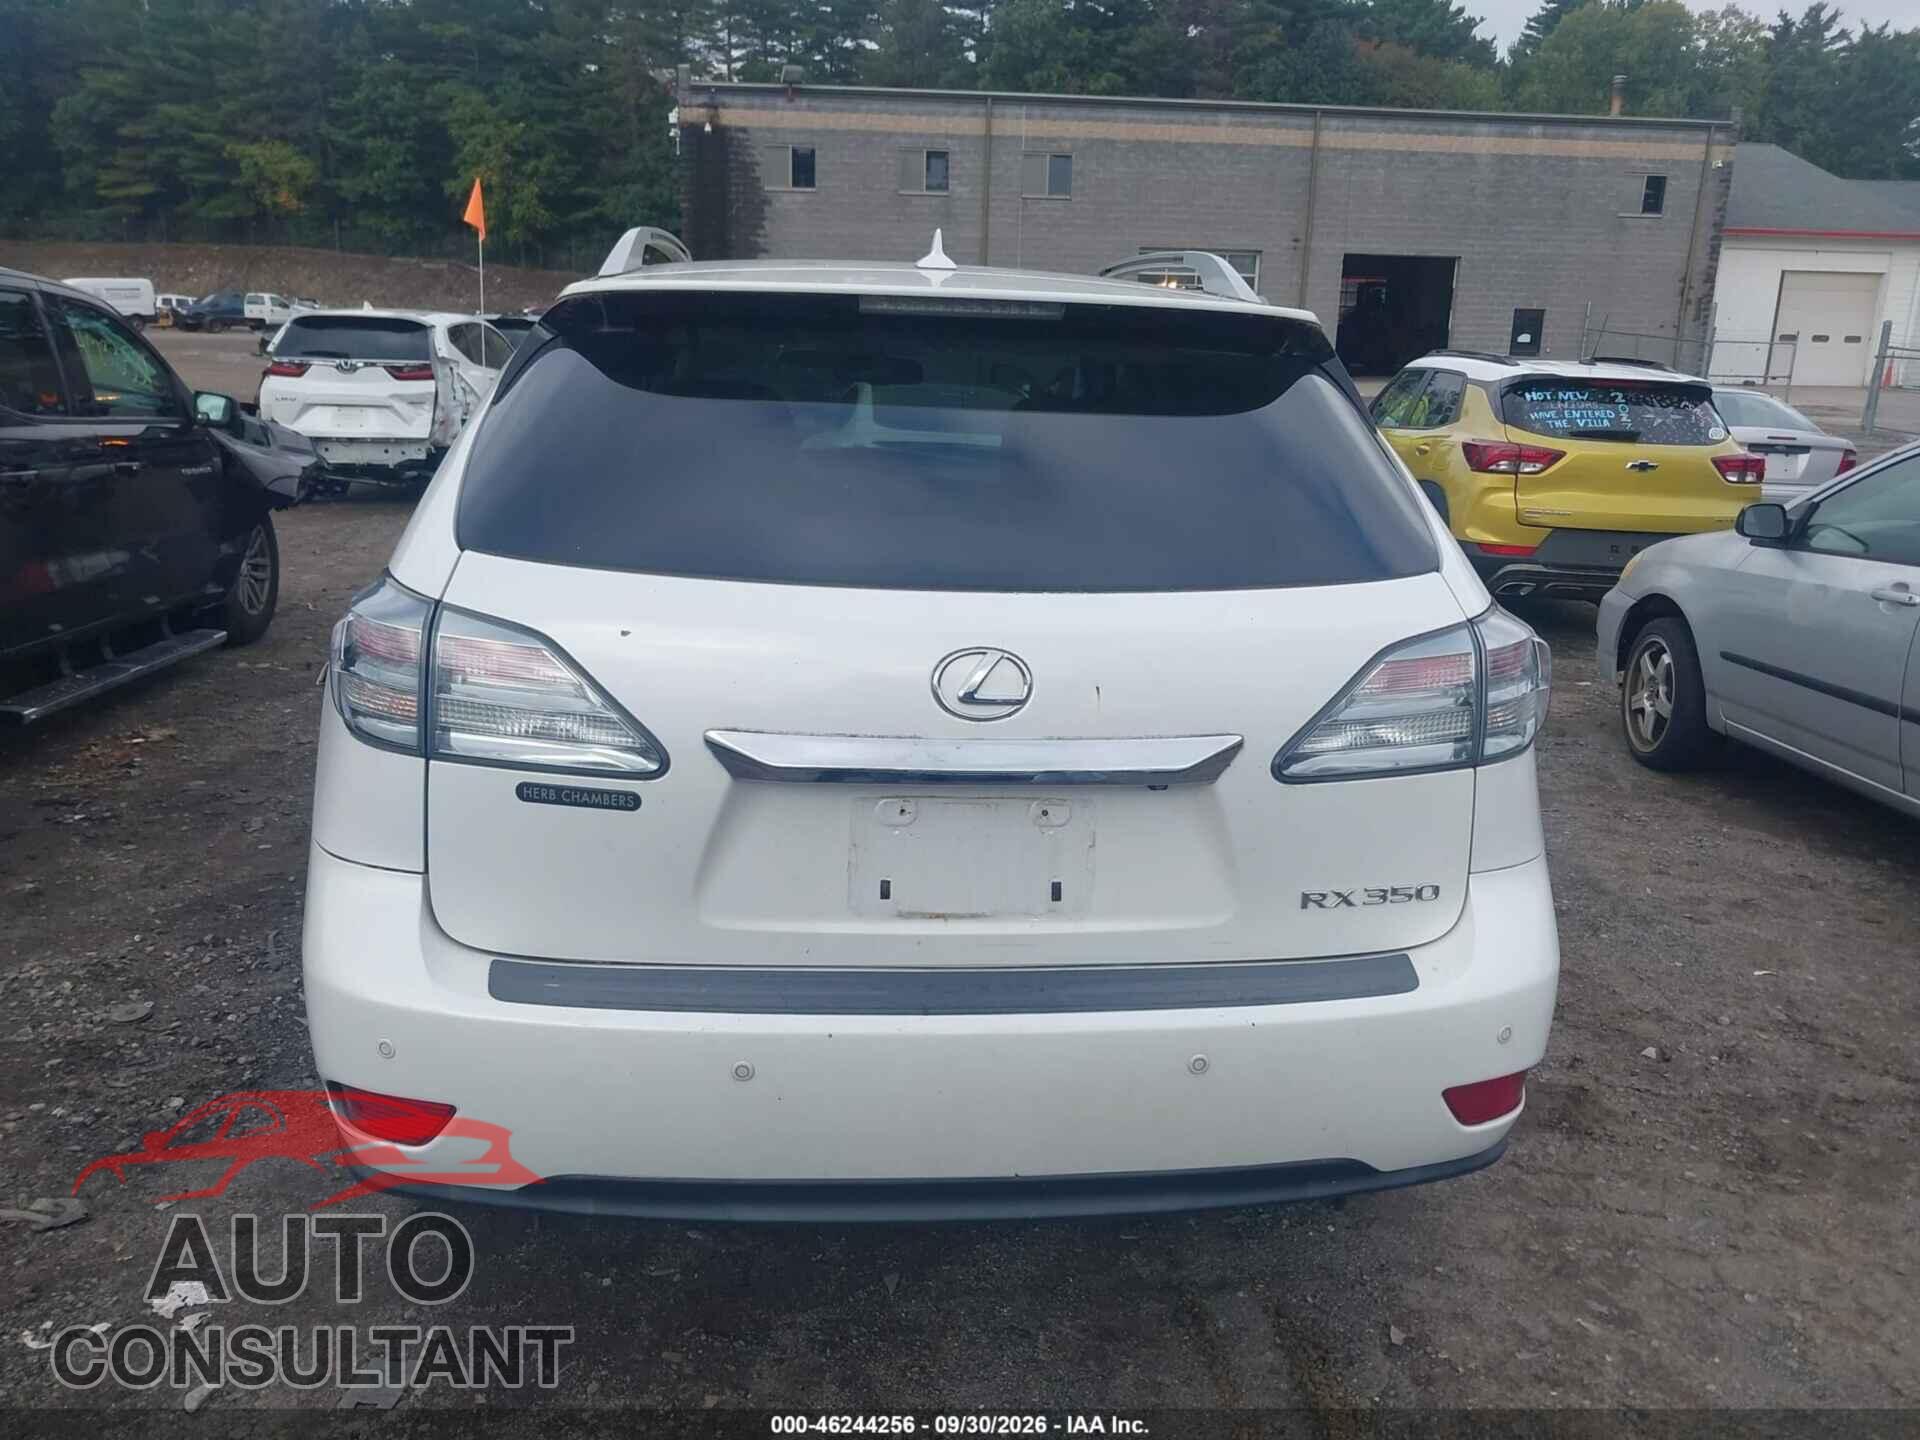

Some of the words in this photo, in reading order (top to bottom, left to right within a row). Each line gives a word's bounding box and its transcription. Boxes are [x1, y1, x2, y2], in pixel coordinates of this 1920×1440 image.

[1558, 392, 1588, 400] NEW
[1530, 410, 1557, 420] HAVE
[1564, 409, 1615, 419] ENTERED
[1546, 419, 1568, 428] THE
[1577, 418, 1610, 428] VILLA
[523, 786, 556, 801] HERB
[561, 789, 635, 808] CHAMBERS
